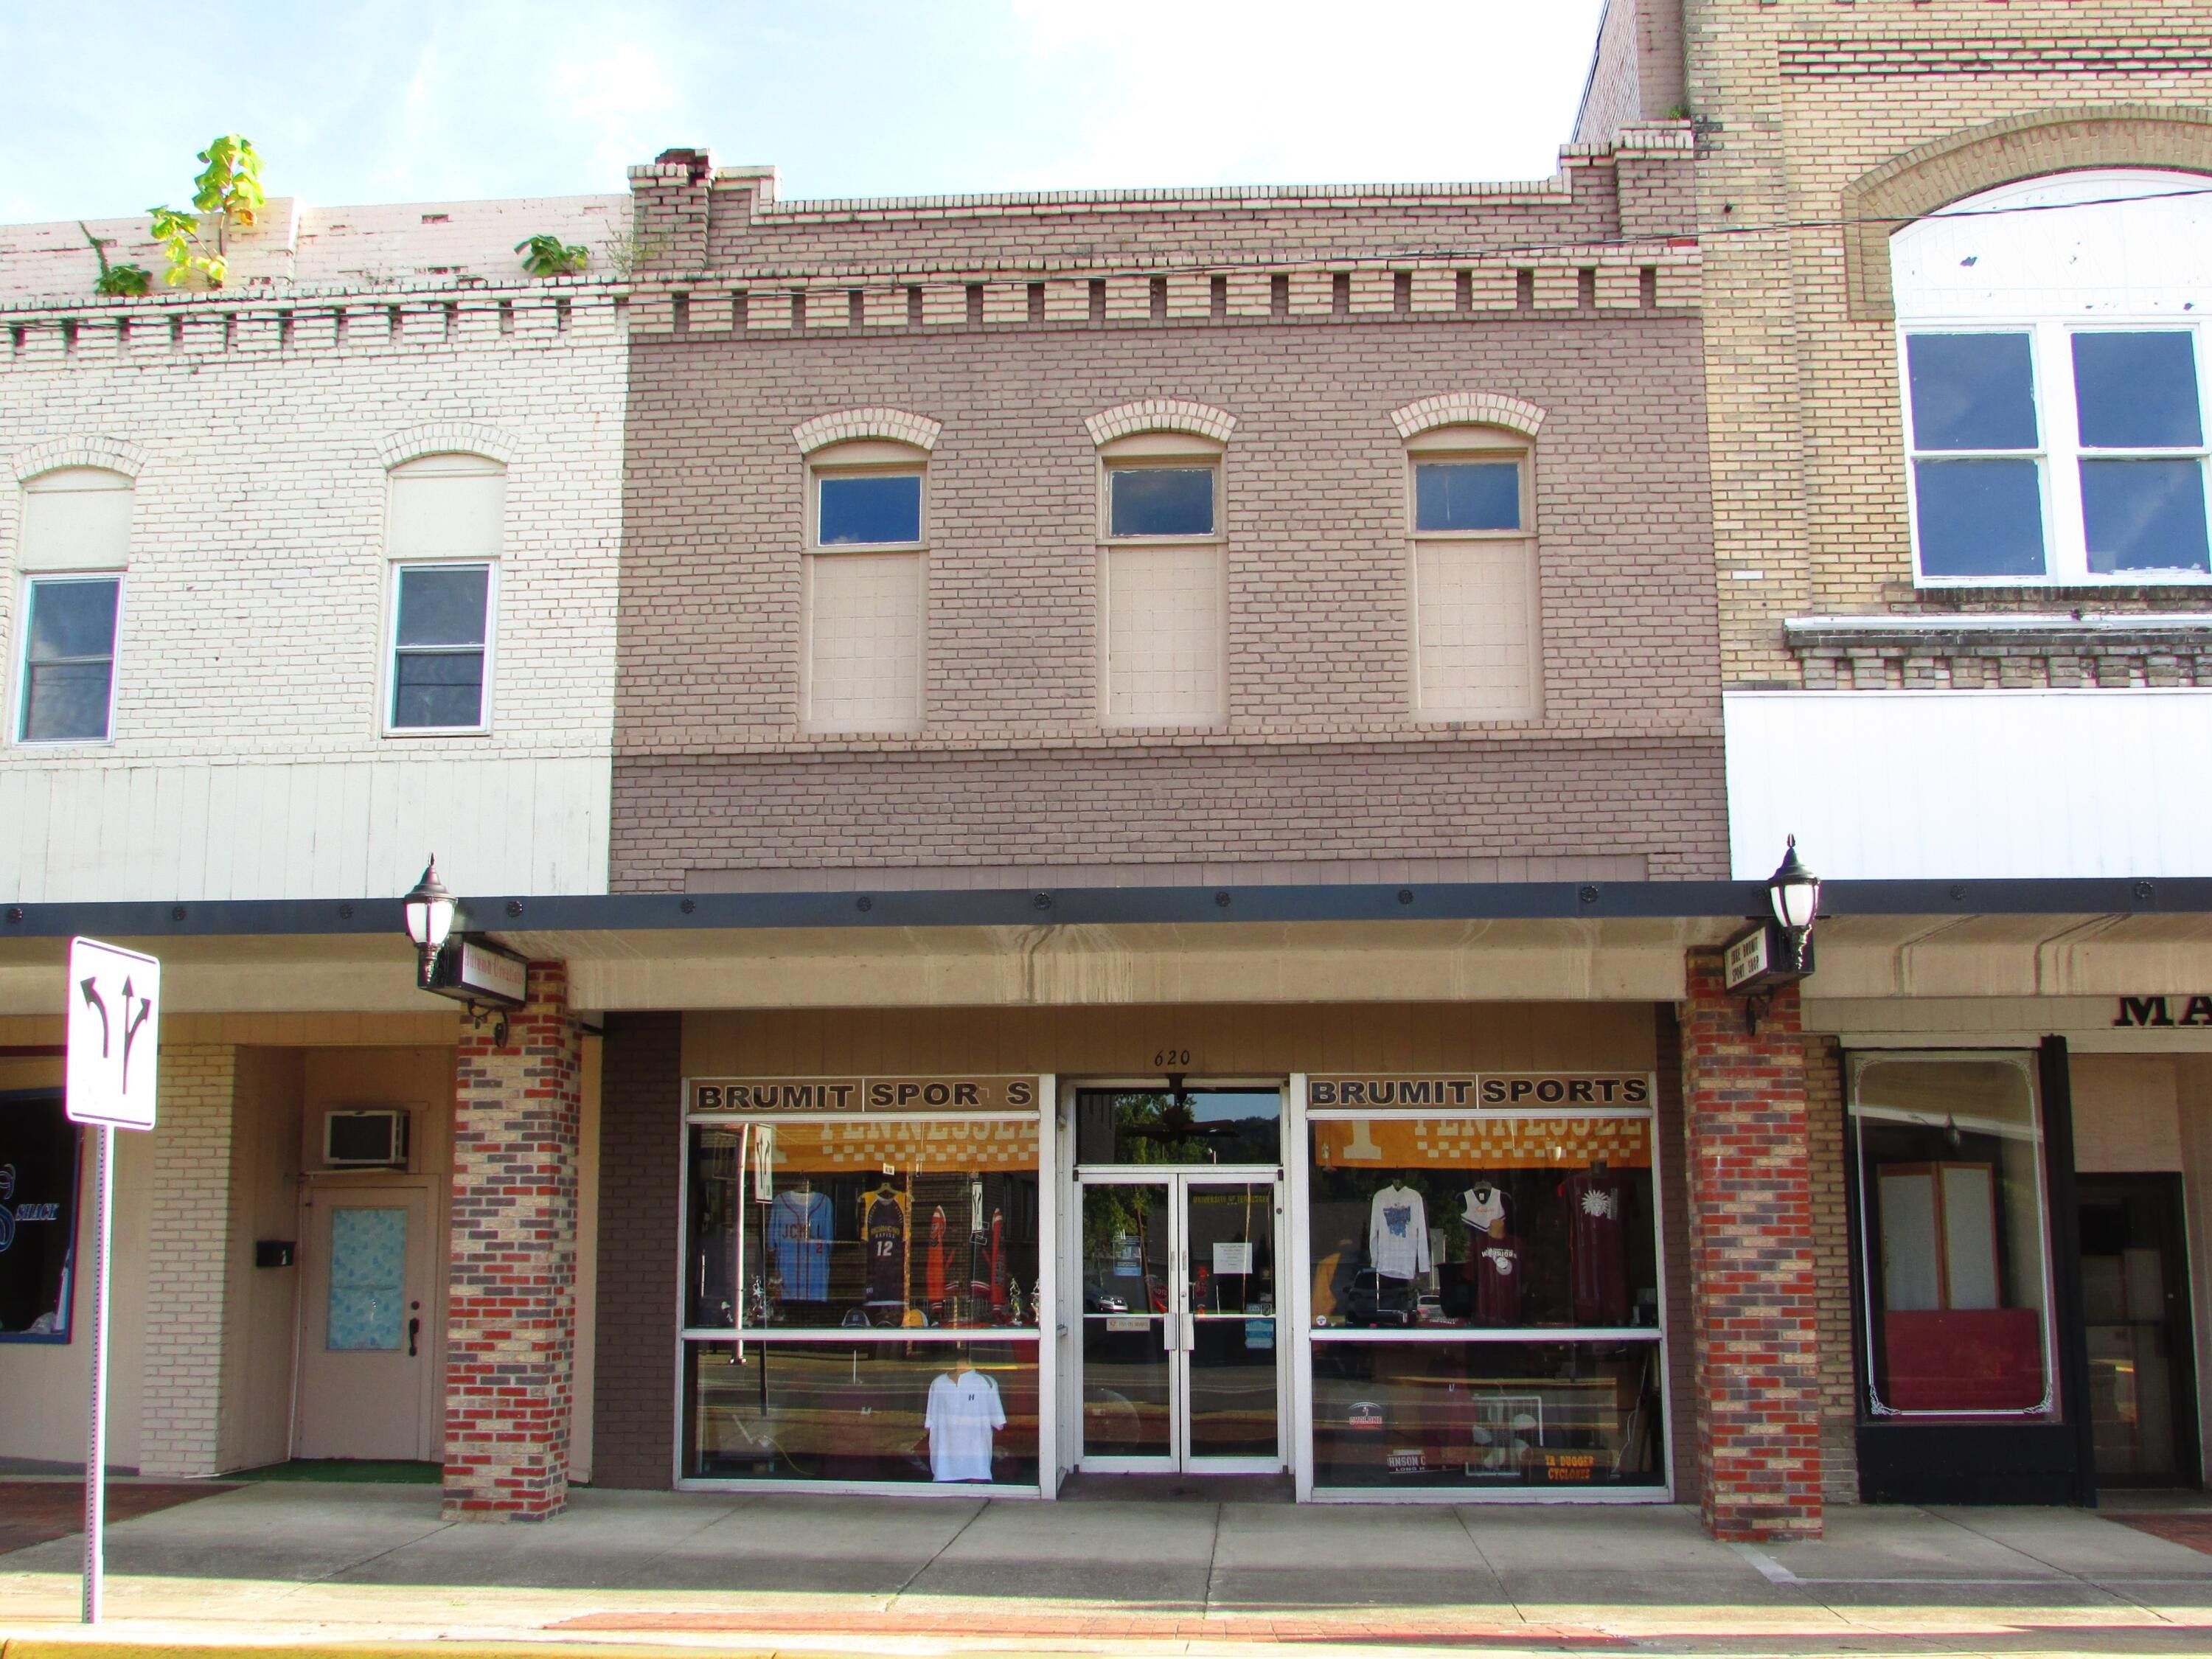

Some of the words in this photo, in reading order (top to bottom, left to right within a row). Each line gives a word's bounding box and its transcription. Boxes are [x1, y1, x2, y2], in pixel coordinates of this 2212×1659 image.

[1155, 1049, 1190, 1067] 620
[698, 1085, 855, 1108] BRUMIT
[1310, 1079, 1474, 1105] BRUMIT
[1481, 1078, 1648, 1103] SPORTS
[876, 1240, 893, 1256] 12
